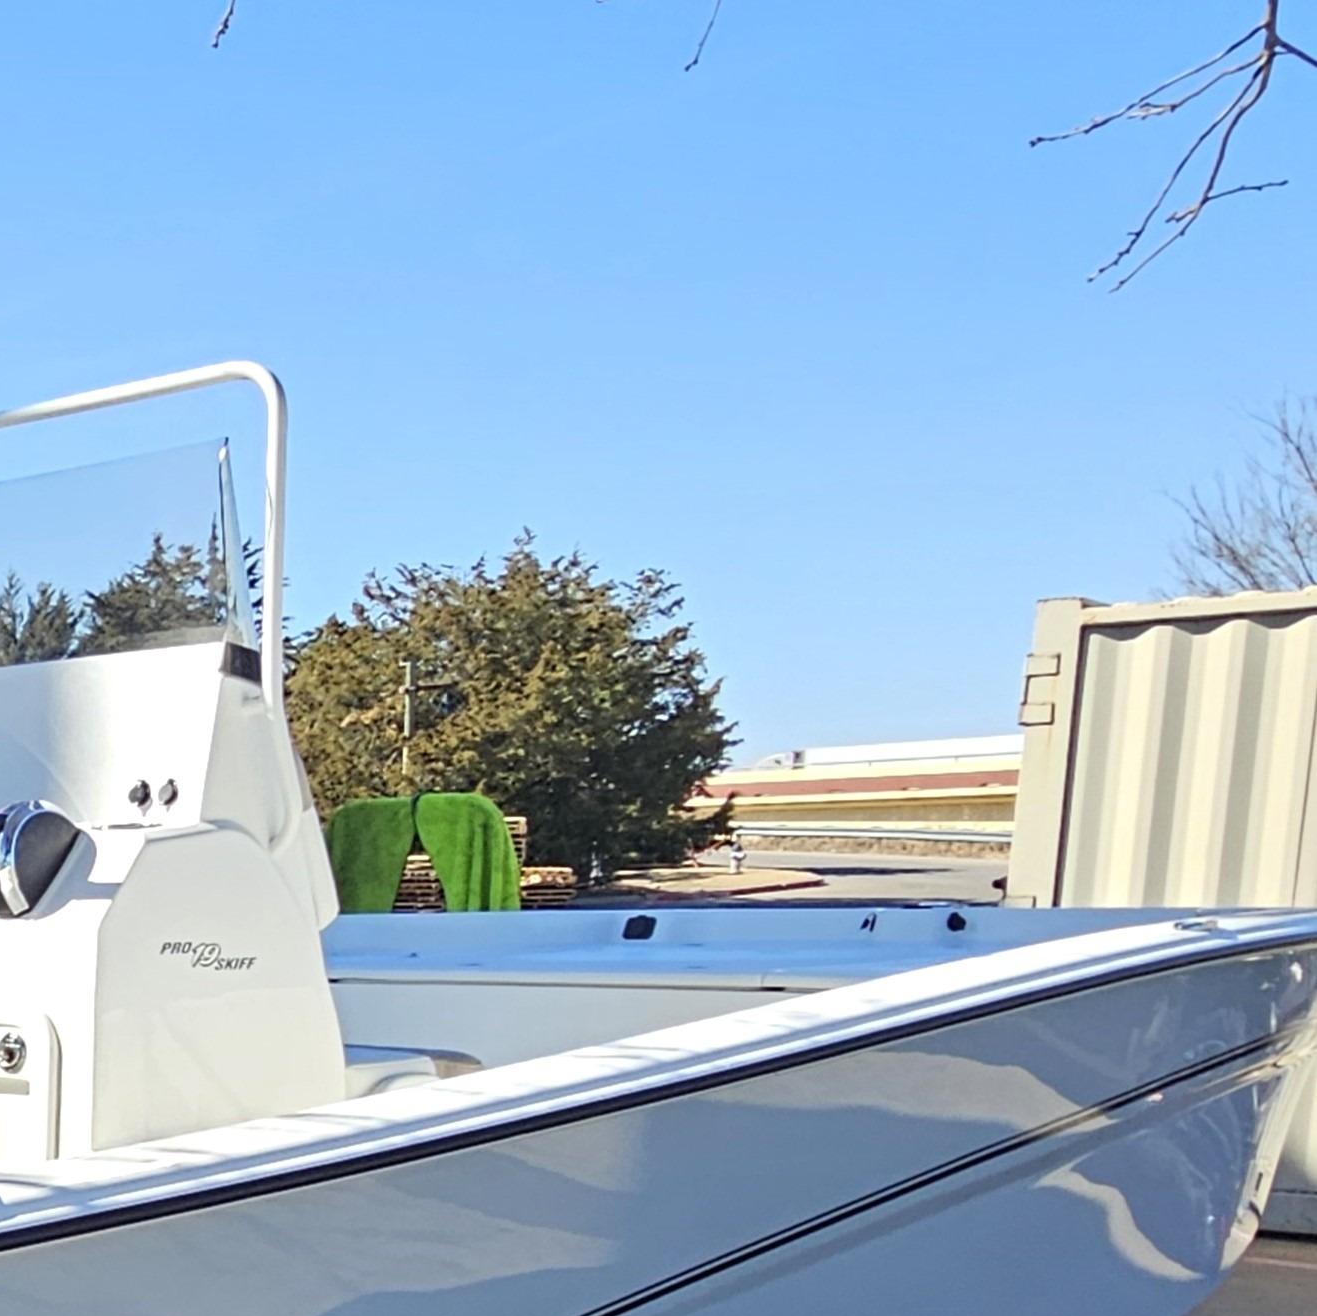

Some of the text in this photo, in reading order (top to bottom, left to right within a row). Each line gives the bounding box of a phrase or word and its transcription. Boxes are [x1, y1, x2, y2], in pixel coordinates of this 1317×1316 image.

[161, 942, 256, 970] PRO 19 SKIFF
